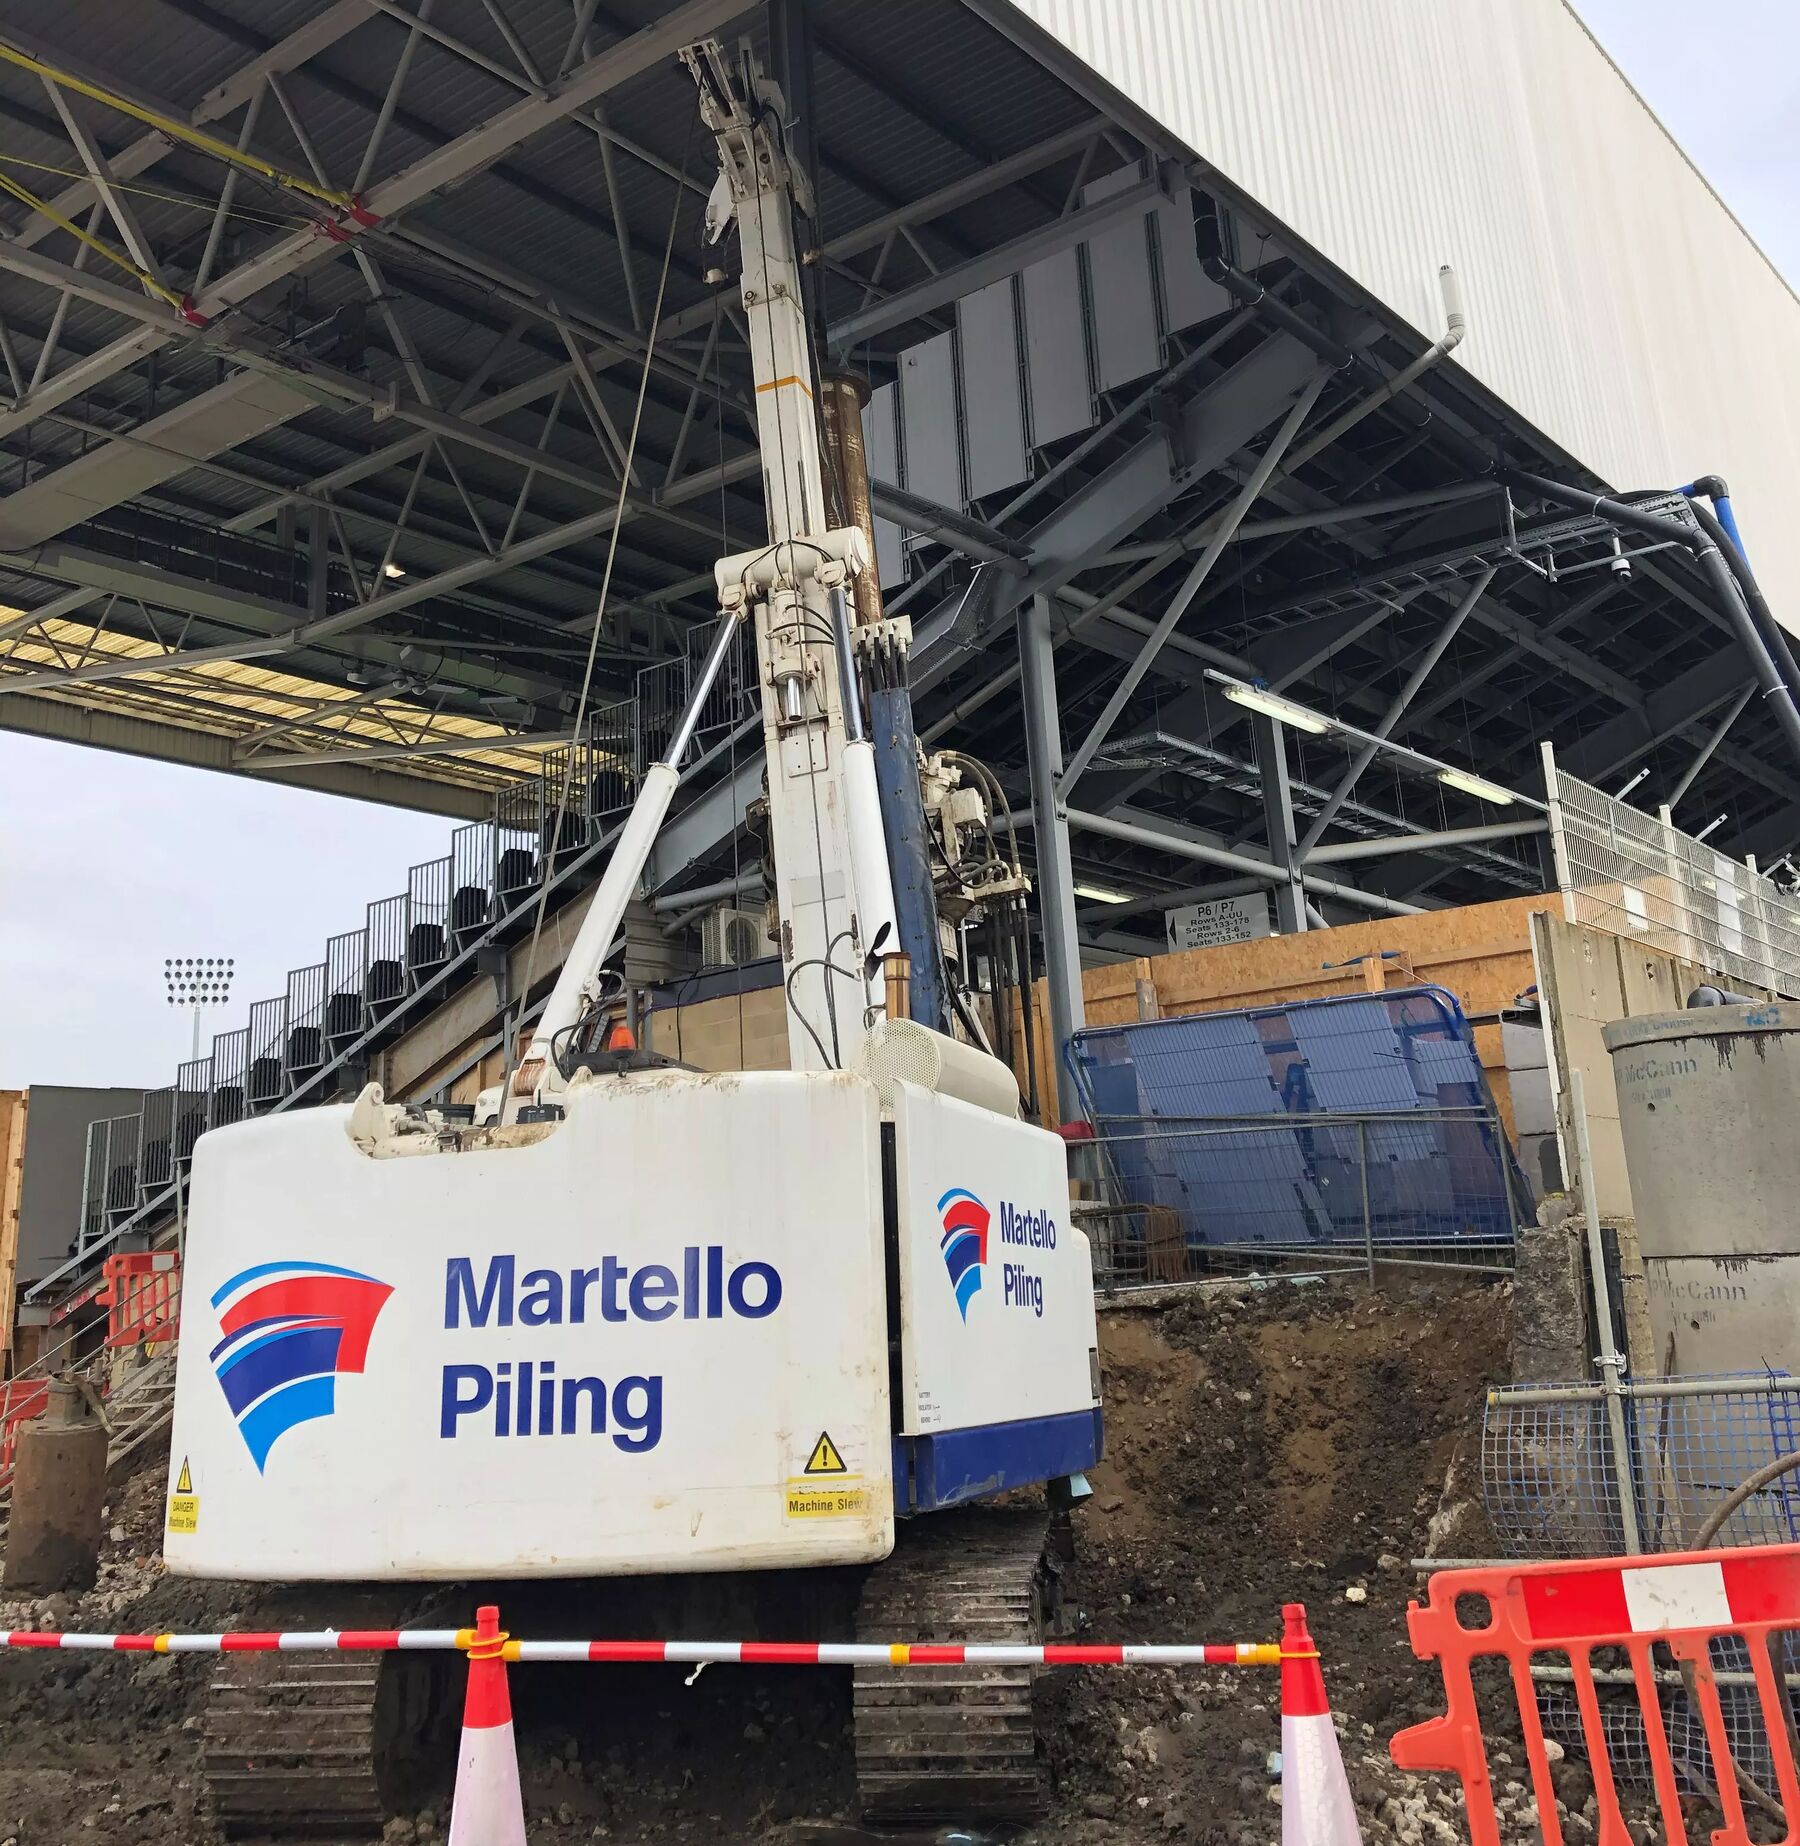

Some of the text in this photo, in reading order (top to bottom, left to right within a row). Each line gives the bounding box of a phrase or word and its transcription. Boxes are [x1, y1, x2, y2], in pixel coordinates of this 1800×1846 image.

[1197, 905, 1212, 918] P6
[1221, 901, 1235, 913] P7
[1185, 917, 1250, 935] Seats 133-178
[1190, 911, 1243, 926] Rows A-UU
[1187, 931, 1252, 948] Seats 133-152
[1196, 925, 1240, 940] Rows 2-6
[1000, 1201, 1056, 1250] Martello
[444, 1246, 782, 1329] Martello
[1003, 1263, 1043, 1317] Piling
[440, 1361, 663, 1454] Piling
[789, 1498, 863, 1512] Machine Slew
